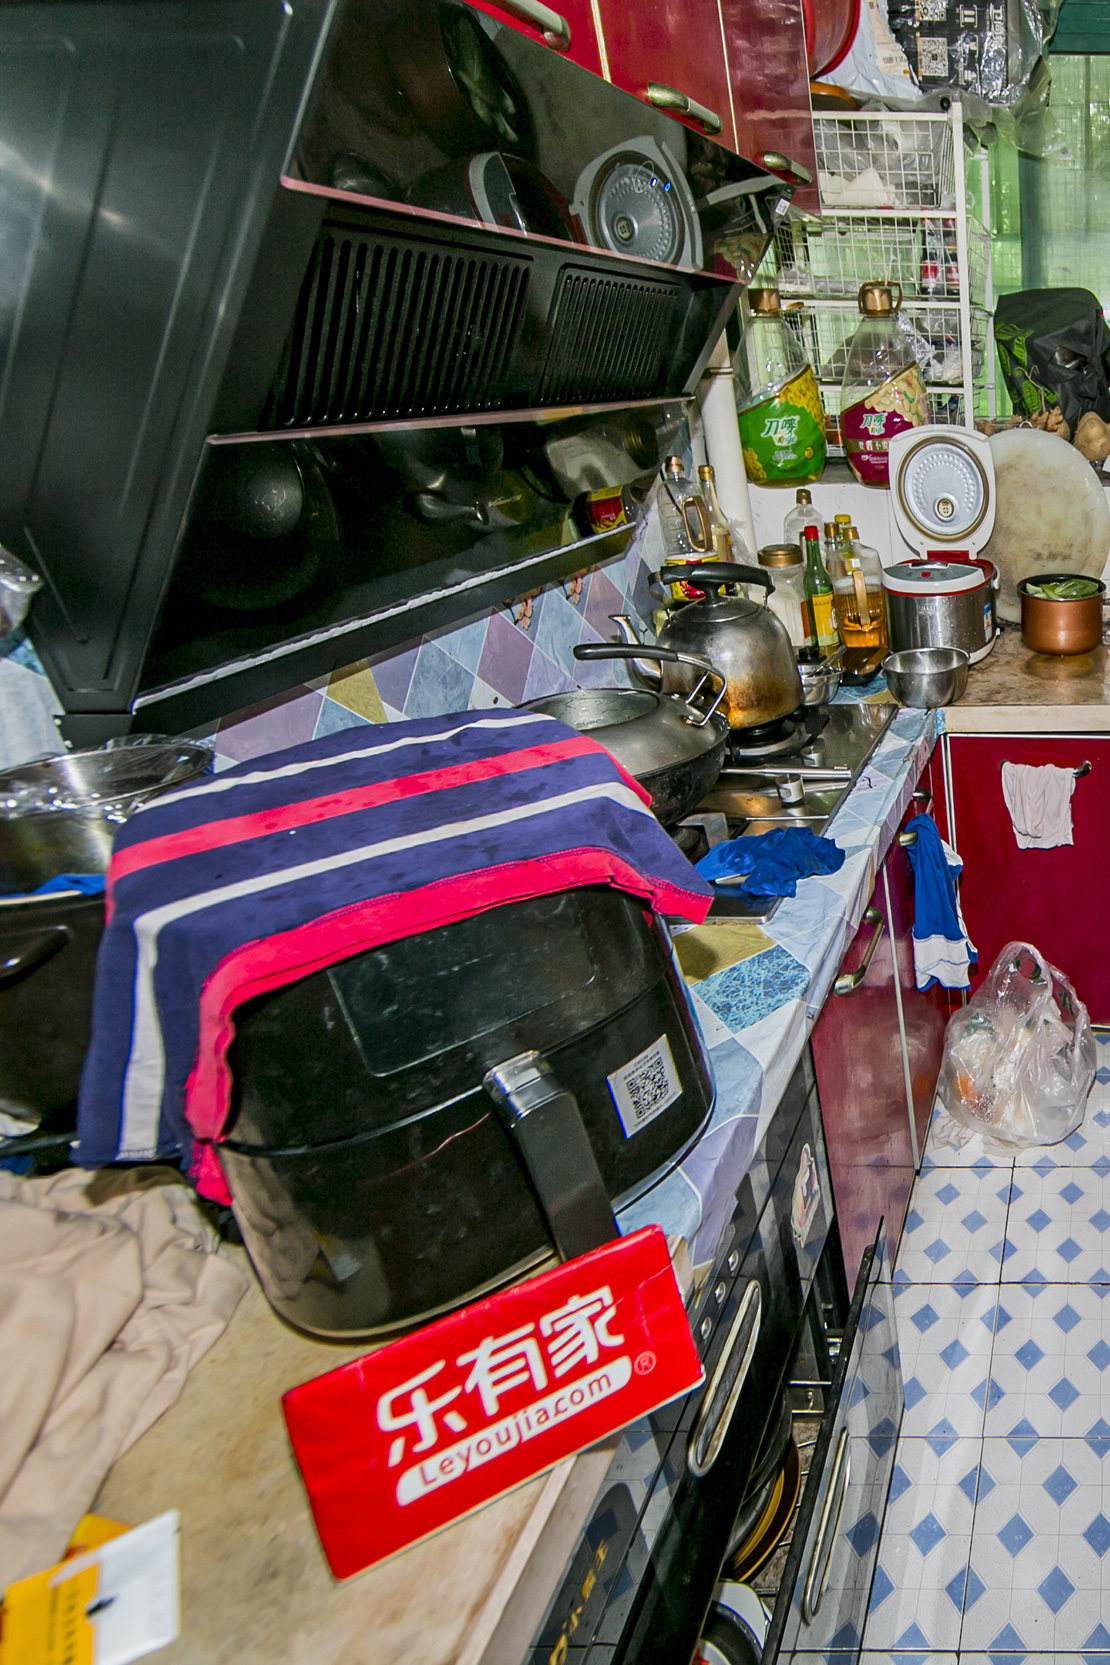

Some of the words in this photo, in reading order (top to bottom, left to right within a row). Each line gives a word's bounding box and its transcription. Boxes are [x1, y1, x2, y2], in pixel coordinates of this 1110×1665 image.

[376, 1285, 626, 1468] 乐有家
[418, 1373, 612, 1488] Leyoujia.com
